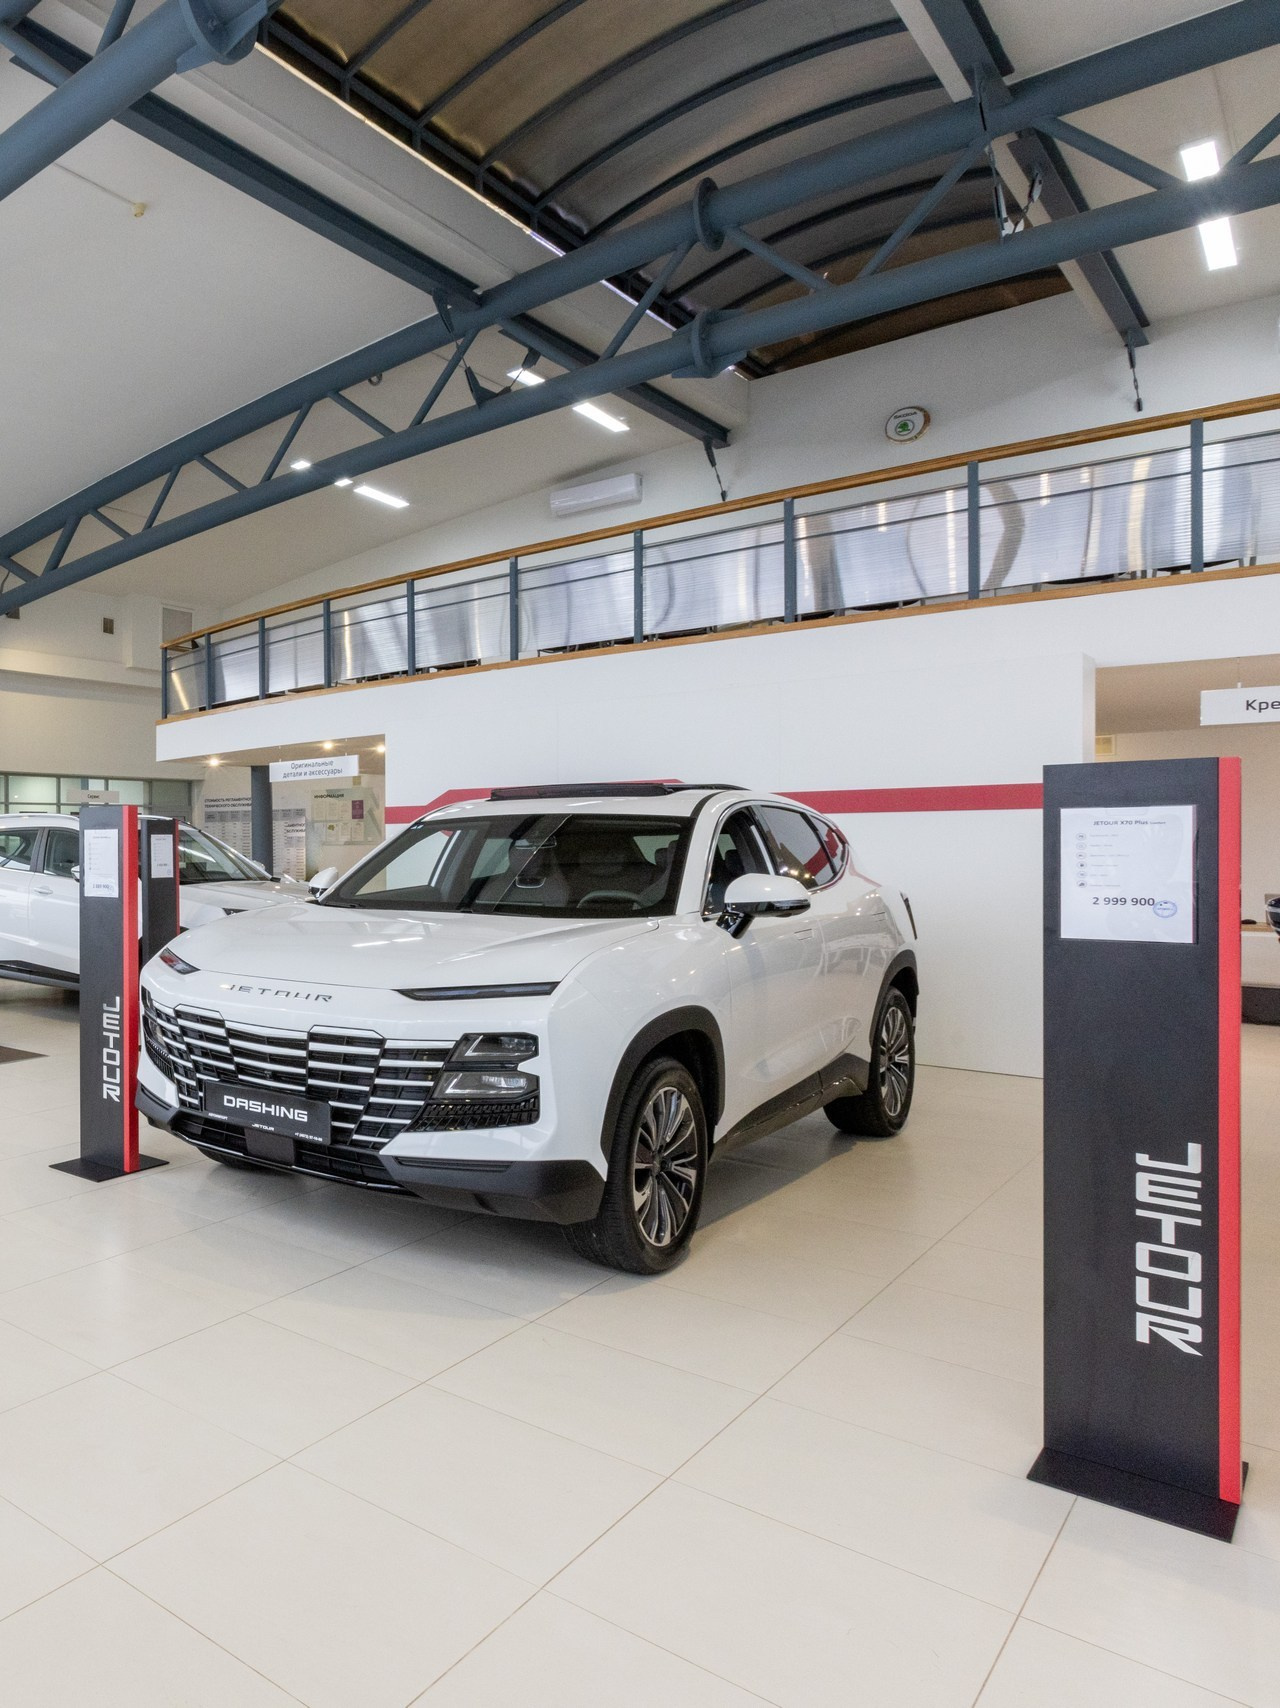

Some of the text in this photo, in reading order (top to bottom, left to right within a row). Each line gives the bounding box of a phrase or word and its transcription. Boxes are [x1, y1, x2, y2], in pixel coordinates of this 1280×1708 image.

[1246, 699, 1280, 713] Кре
[291, 760, 334, 770] Оригинальные
[282, 770, 302, 779] детали
[308, 768, 343, 776] аксессуары
[1092, 896, 1155, 906] 2 999 900
[220, 984, 333, 1002] JETOUR
[103, 996, 120, 1103] JETOUR
[223, 1095, 309, 1123] DASHING
[251, 1123, 275, 1131] JETOUR
[1135, 1142, 1203, 1357] JETOUR
